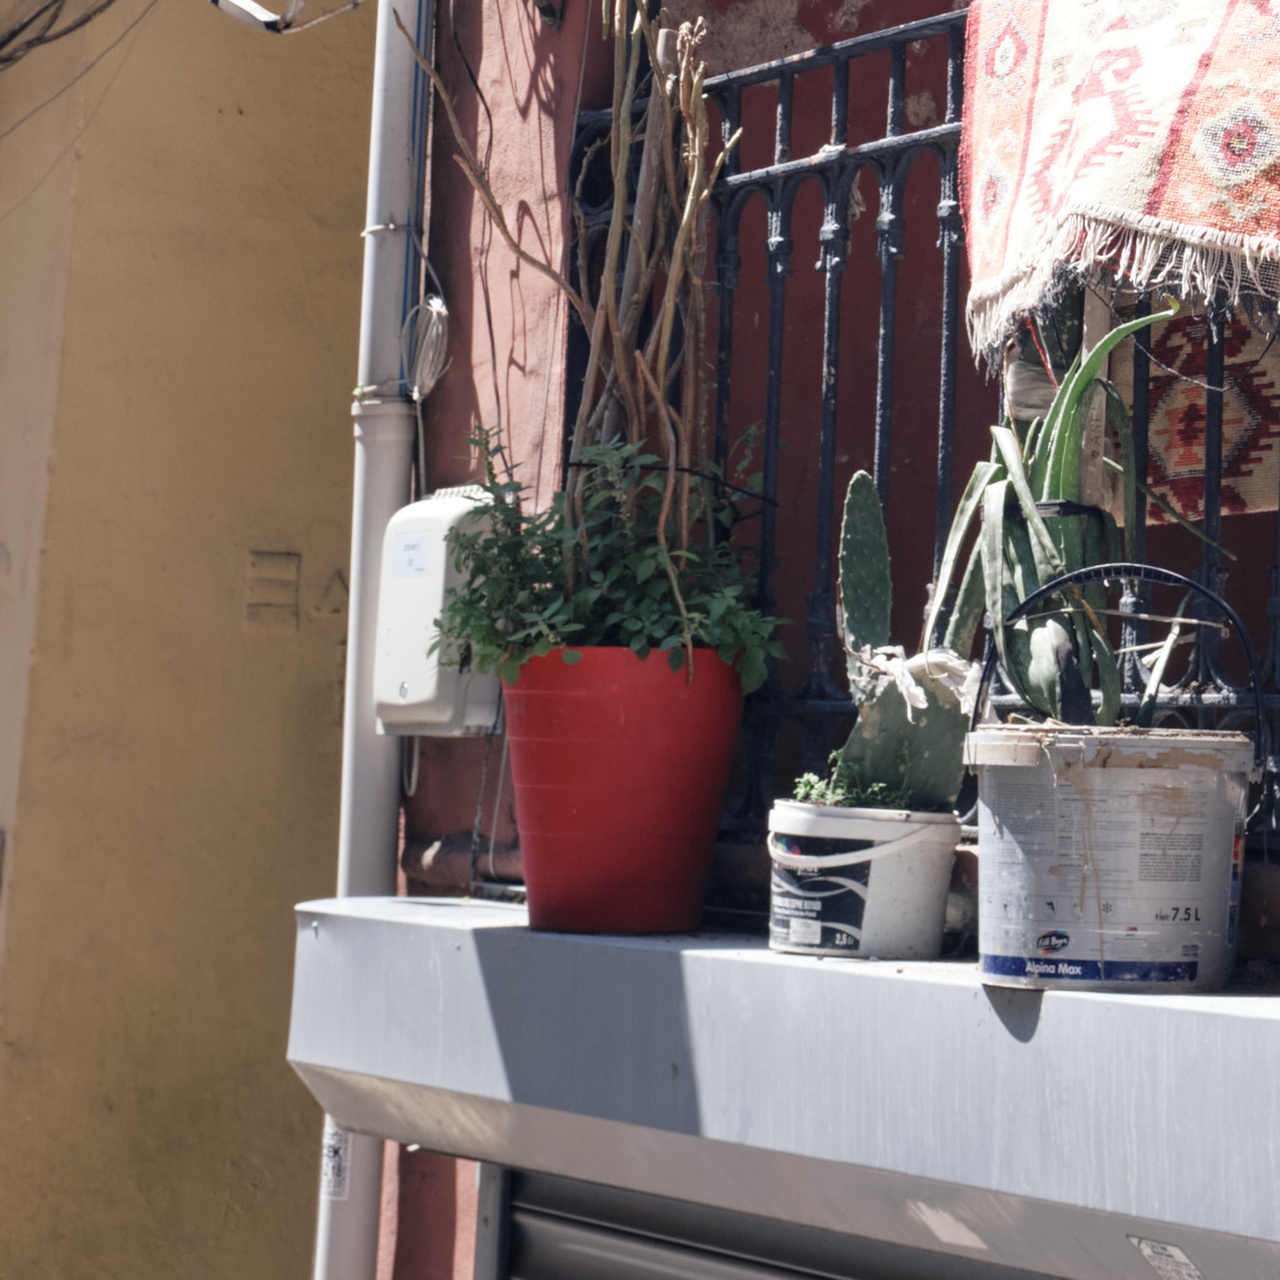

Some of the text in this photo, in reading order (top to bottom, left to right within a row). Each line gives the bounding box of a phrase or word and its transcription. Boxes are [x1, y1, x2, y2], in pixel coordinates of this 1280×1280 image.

[1172, 908, 1191, 921] 7.5
[1195, 908, 1201, 921] L
[1025, 961, 1082, 975] Alpina Max
